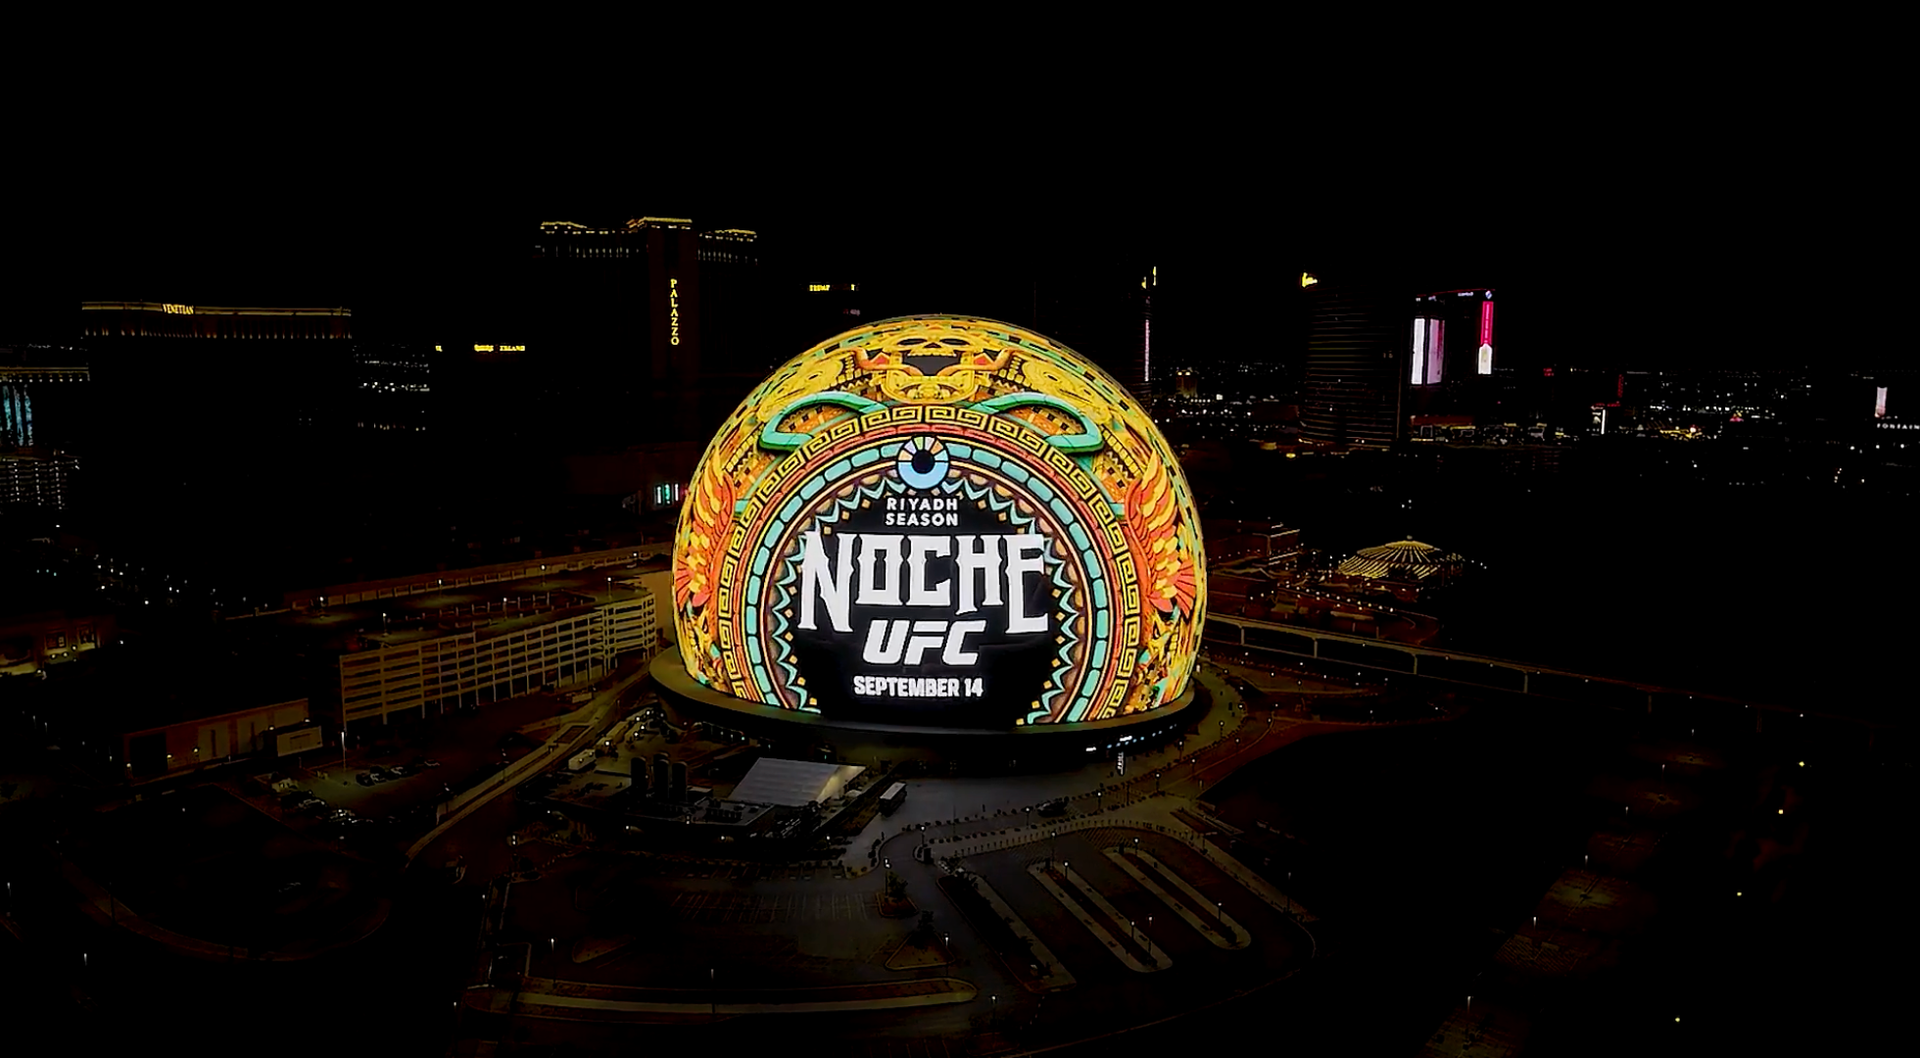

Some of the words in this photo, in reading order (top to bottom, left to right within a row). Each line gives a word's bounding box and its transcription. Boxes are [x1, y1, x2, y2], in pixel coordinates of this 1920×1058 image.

[162, 303, 194, 316] VENETIAN
[669, 278, 680, 346] PALAZZO
[886, 497, 958, 511] RIYADH
[885, 512, 959, 527] SEASON
[797, 531, 1049, 634] NOCHE
[862, 619, 987, 666] UFC
[853, 675, 960, 698] SEPTEMBER
[963, 676, 984, 698] 14
